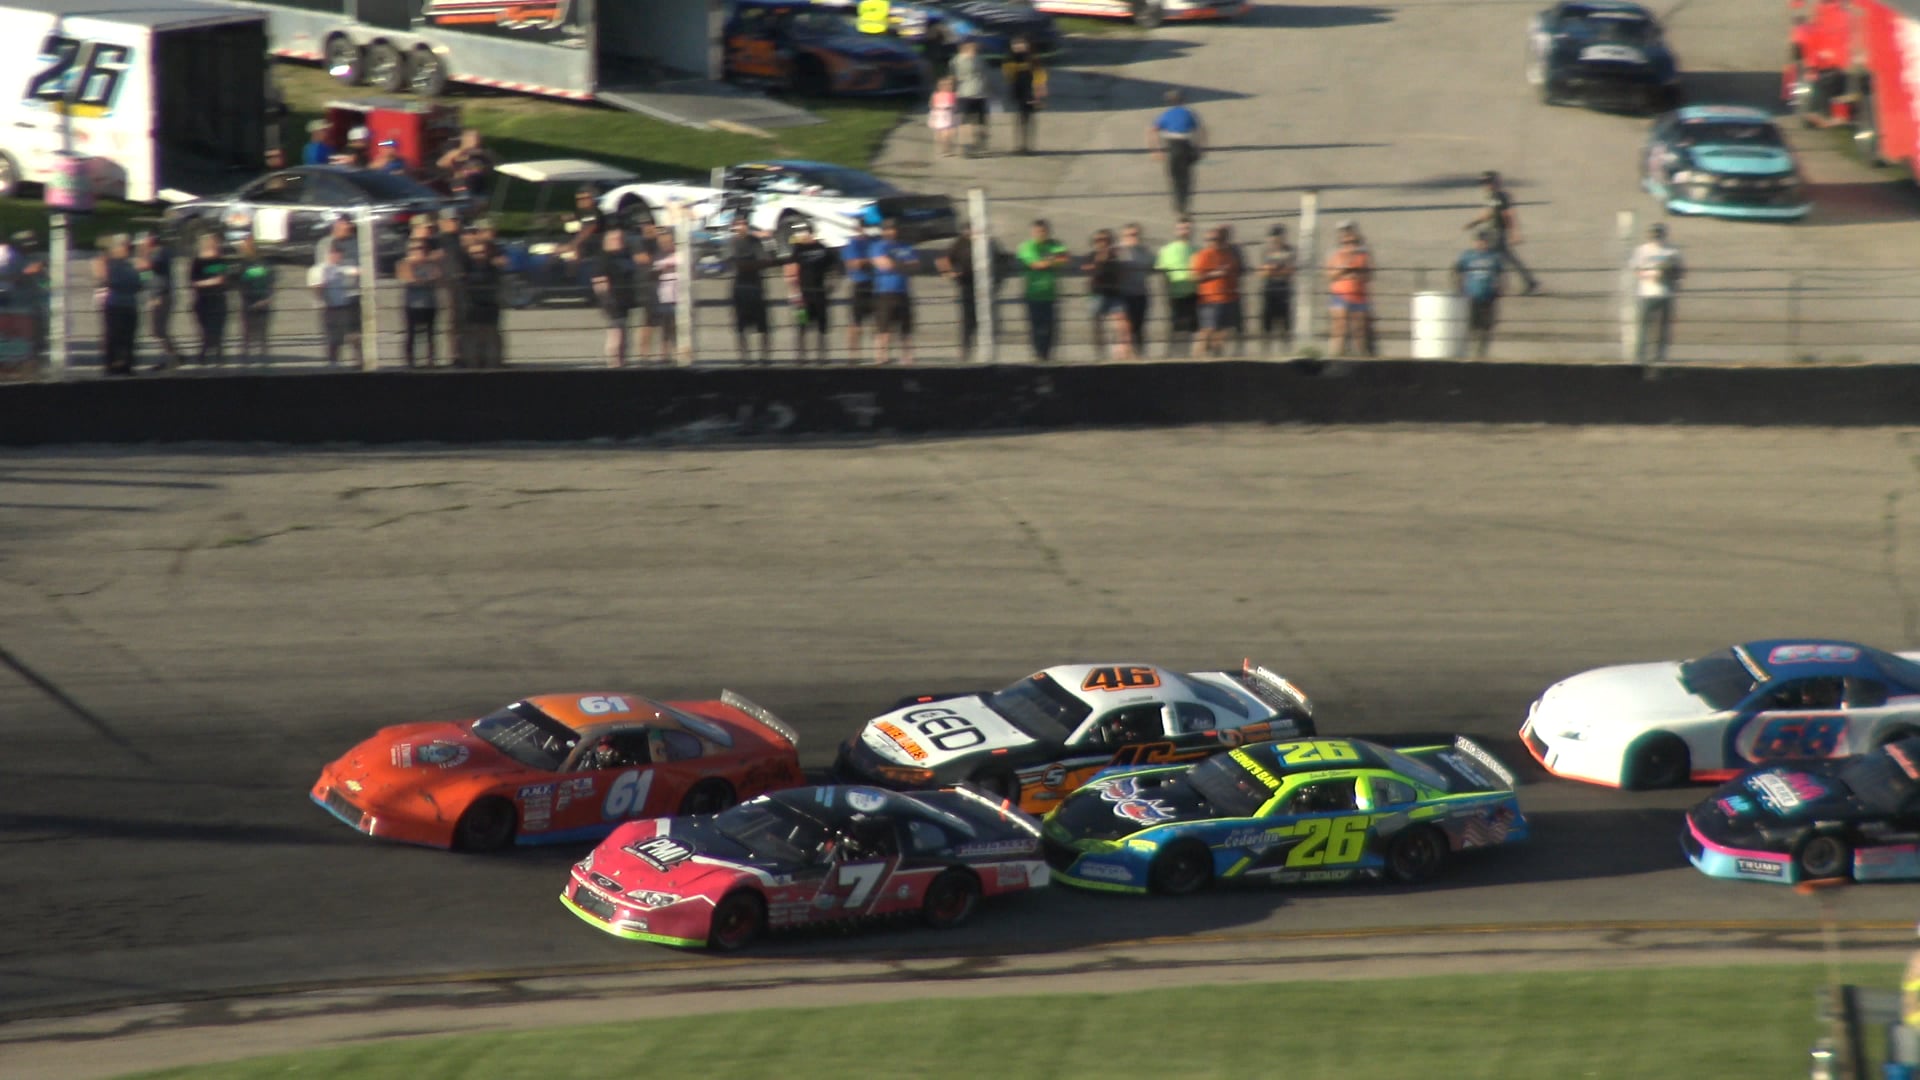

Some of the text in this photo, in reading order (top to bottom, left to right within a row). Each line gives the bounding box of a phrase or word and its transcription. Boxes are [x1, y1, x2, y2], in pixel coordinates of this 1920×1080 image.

[27, 35, 131, 105] 26
[1081, 667, 1161, 692] 46
[578, 696, 630, 716] 61
[1272, 740, 1361, 768] 26
[1256, 771, 1281, 789] BAR
[604, 770, 655, 820] 61
[639, 839, 690, 862] PMI
[1286, 816, 1371, 868] 26
[1738, 859, 1781, 871] TRUMP
[839, 862, 887, 908] 7
